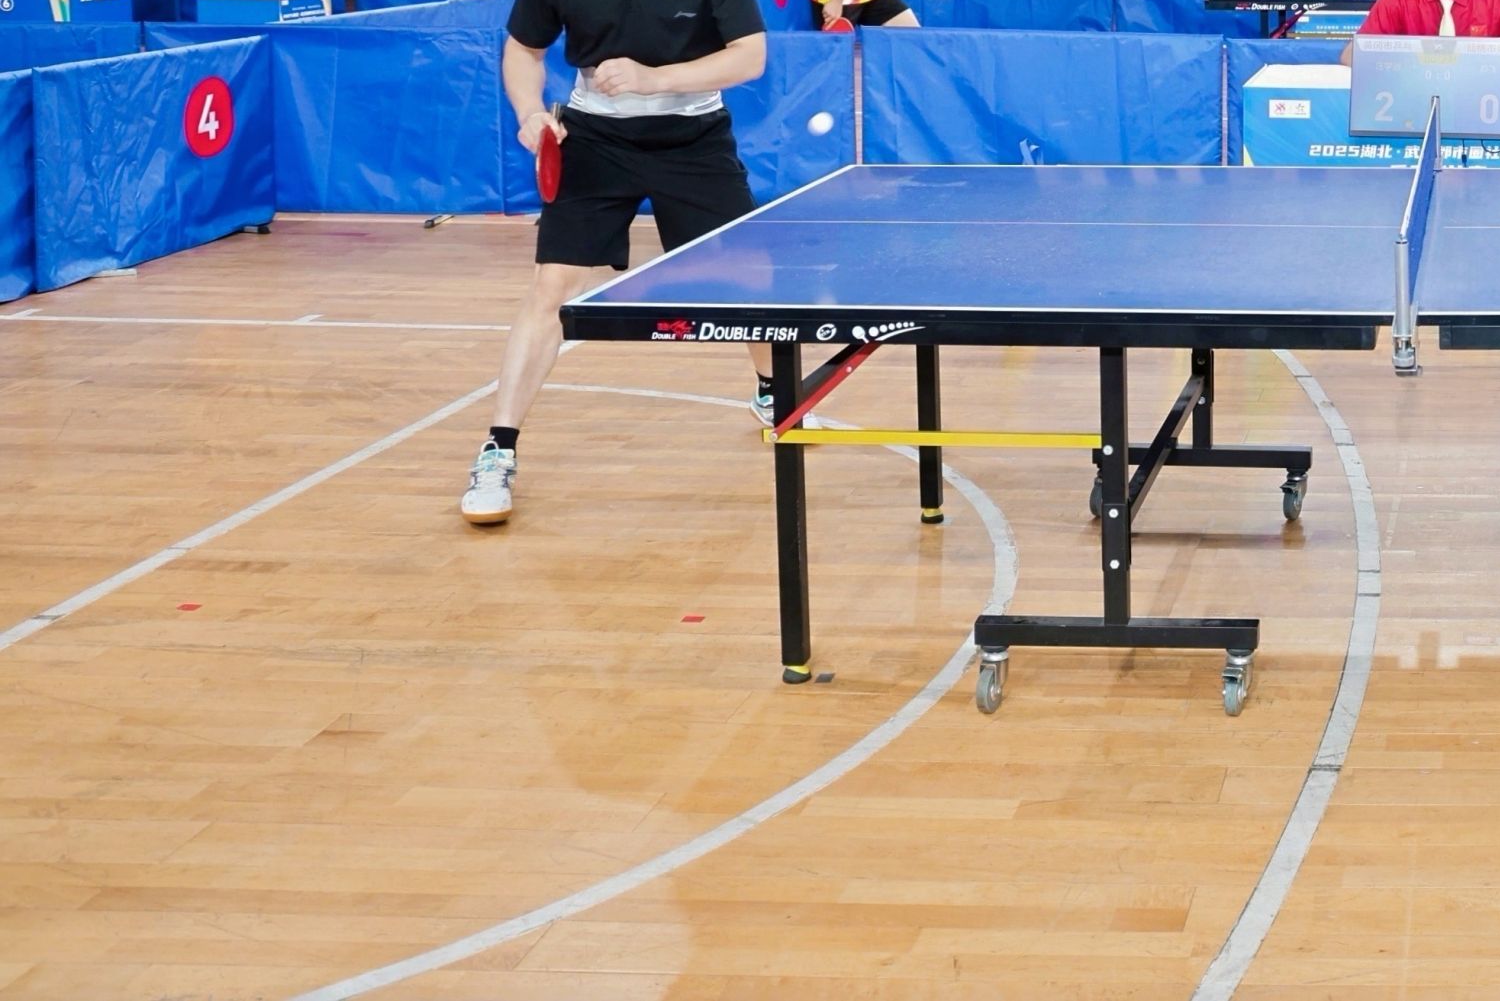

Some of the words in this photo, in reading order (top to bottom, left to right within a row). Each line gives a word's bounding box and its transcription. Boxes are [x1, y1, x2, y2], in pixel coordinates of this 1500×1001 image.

[197, 93, 220, 141] 4
[1374, 91, 1394, 122] 2
[1479, 94, 1500, 124] 0
[698, 322, 762, 341] DOUBLE
[764, 327, 799, 342] FISH
